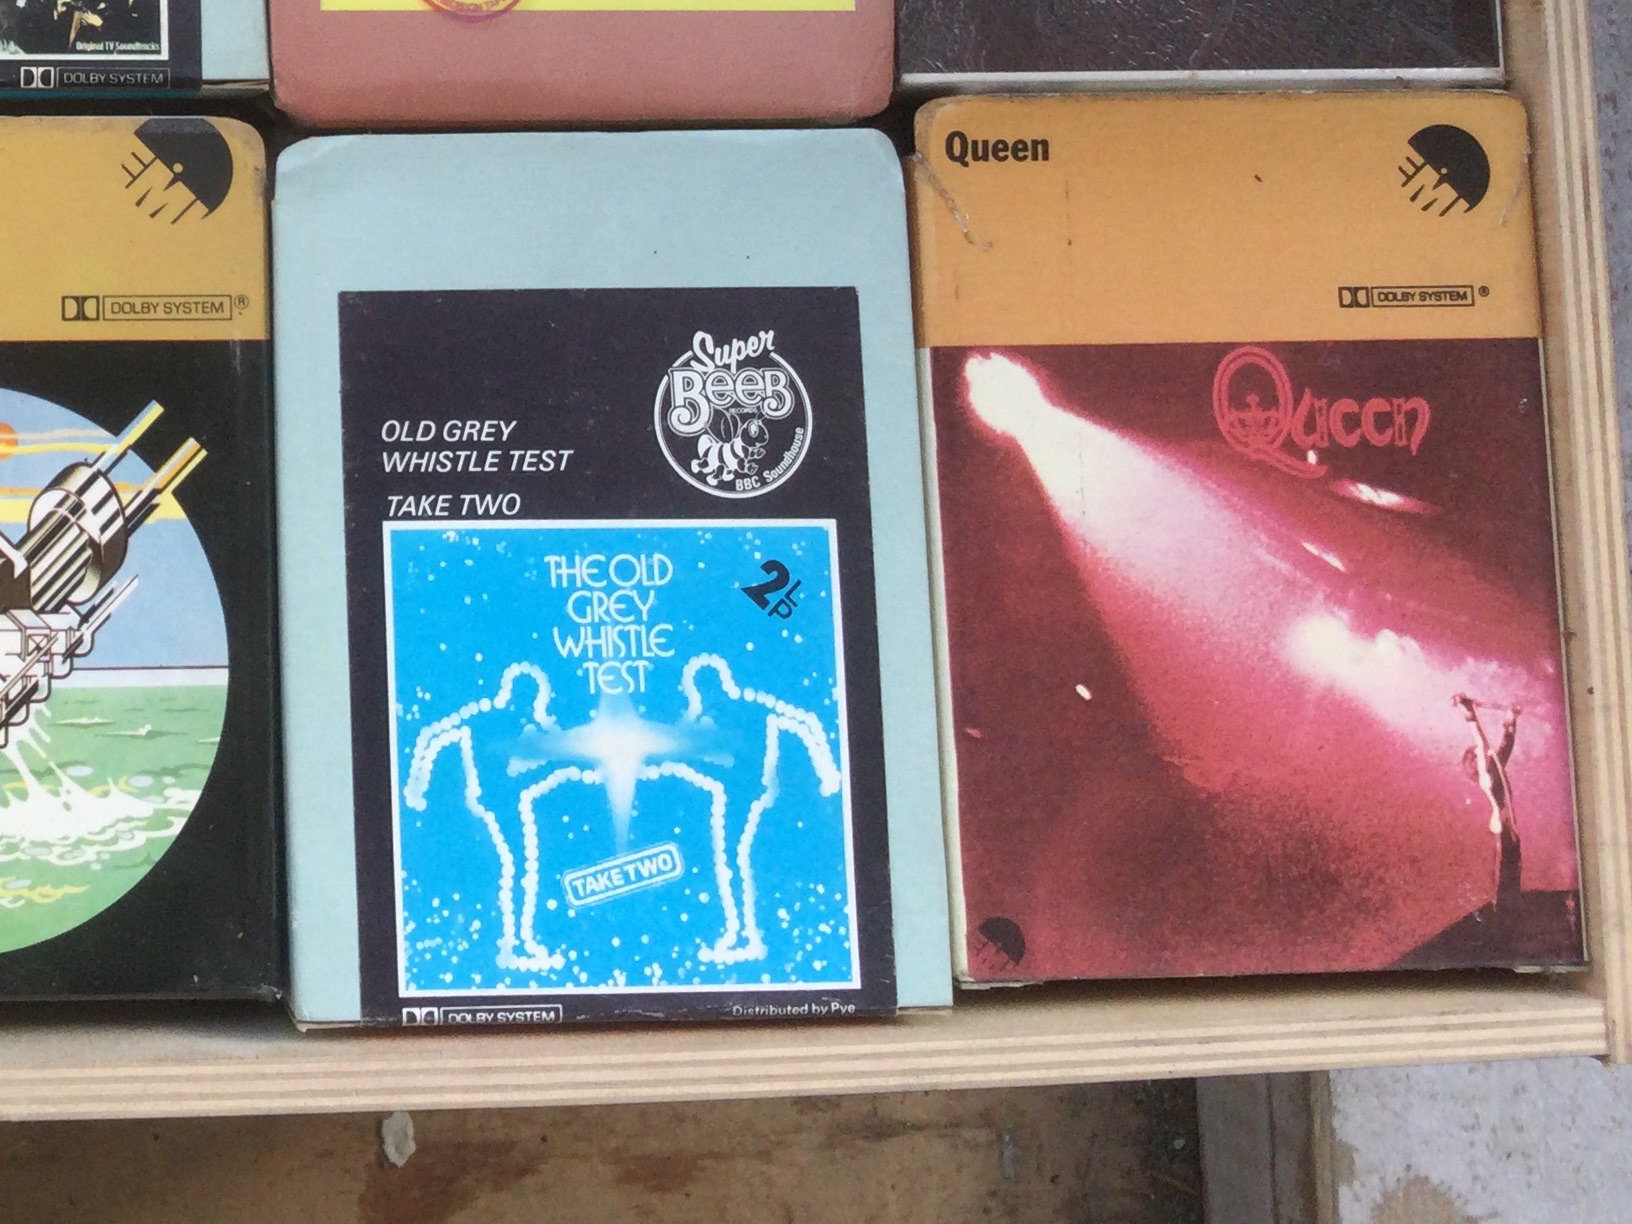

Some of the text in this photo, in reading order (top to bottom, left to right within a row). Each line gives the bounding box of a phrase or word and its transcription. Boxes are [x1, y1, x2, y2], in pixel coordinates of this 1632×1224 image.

[944, 130, 1051, 169] Queen
[1212, 345, 1432, 478] Queen
[380, 420, 518, 443] OLD GREY
[381, 449, 575, 473] WHISTLE TEST
[735, 426, 805, 492] BBC Soundhouse
[386, 493, 522, 517] TAKE TWO
[543, 553, 674, 588] THE OLD
[565, 589, 657, 624] GREY
[551, 625, 676, 658] WHISTLE
[582, 659, 655, 695] TEST
[571, 853, 675, 897] TAKE TWO
[731, 1002, 856, 1019] Distributed by Pye
